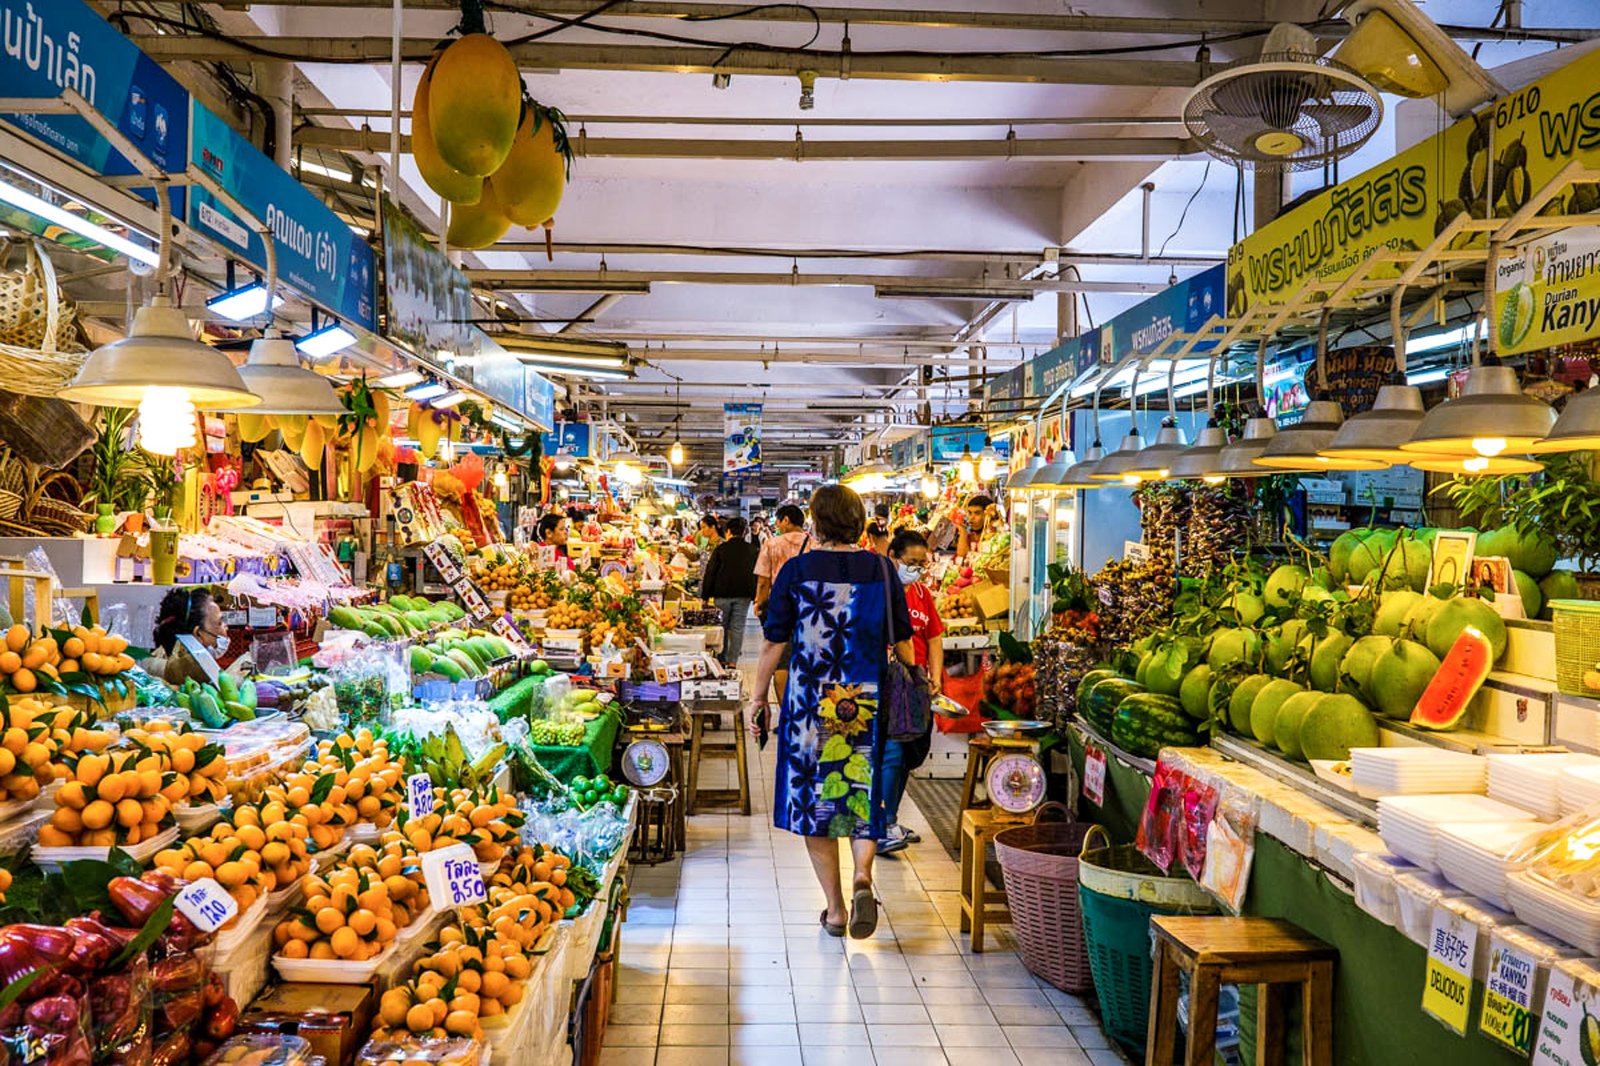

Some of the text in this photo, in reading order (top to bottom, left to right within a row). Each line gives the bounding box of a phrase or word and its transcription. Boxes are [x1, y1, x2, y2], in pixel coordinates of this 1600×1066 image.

[1496, 86, 1541, 129] 6/10
[1498, 259, 1525, 278] Organic
[1545, 288, 1578, 306] Durian
[444, 859, 480, 880] โลละ
[450, 878, 486, 904] 250
[200, 899, 227, 926] 120
[1433, 928, 1469, 968] 真好吃
[1430, 968, 1466, 1006] DELICIOUS
[1499, 964, 1528, 990] KANYAO
